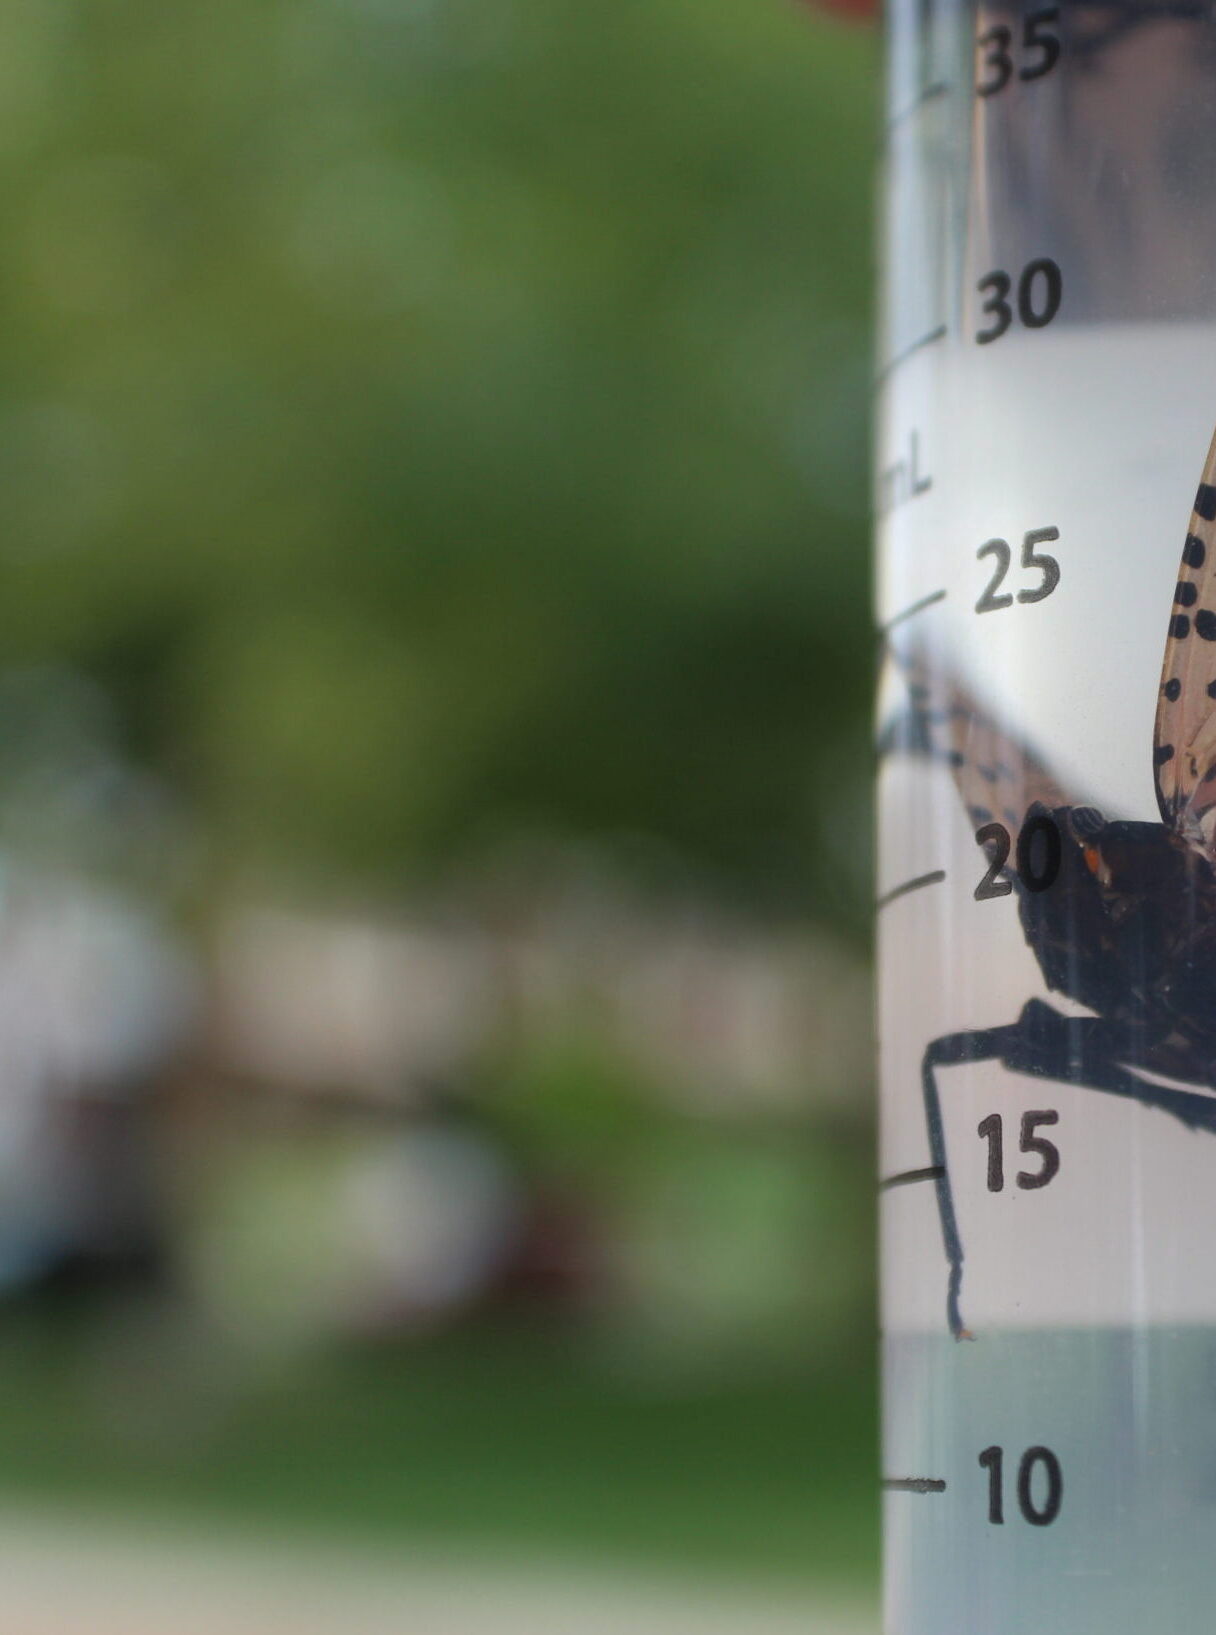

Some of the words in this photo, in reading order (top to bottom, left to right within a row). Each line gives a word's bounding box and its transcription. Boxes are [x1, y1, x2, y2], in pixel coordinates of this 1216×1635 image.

[976, 7, 1060, 98] 35
[976, 258, 1062, 345] 30
[975, 525, 1060, 614] 25
[974, 815, 1061, 901] 20
[978, 1109, 1060, 1192] 15
[979, 1446, 1063, 1527] 10
